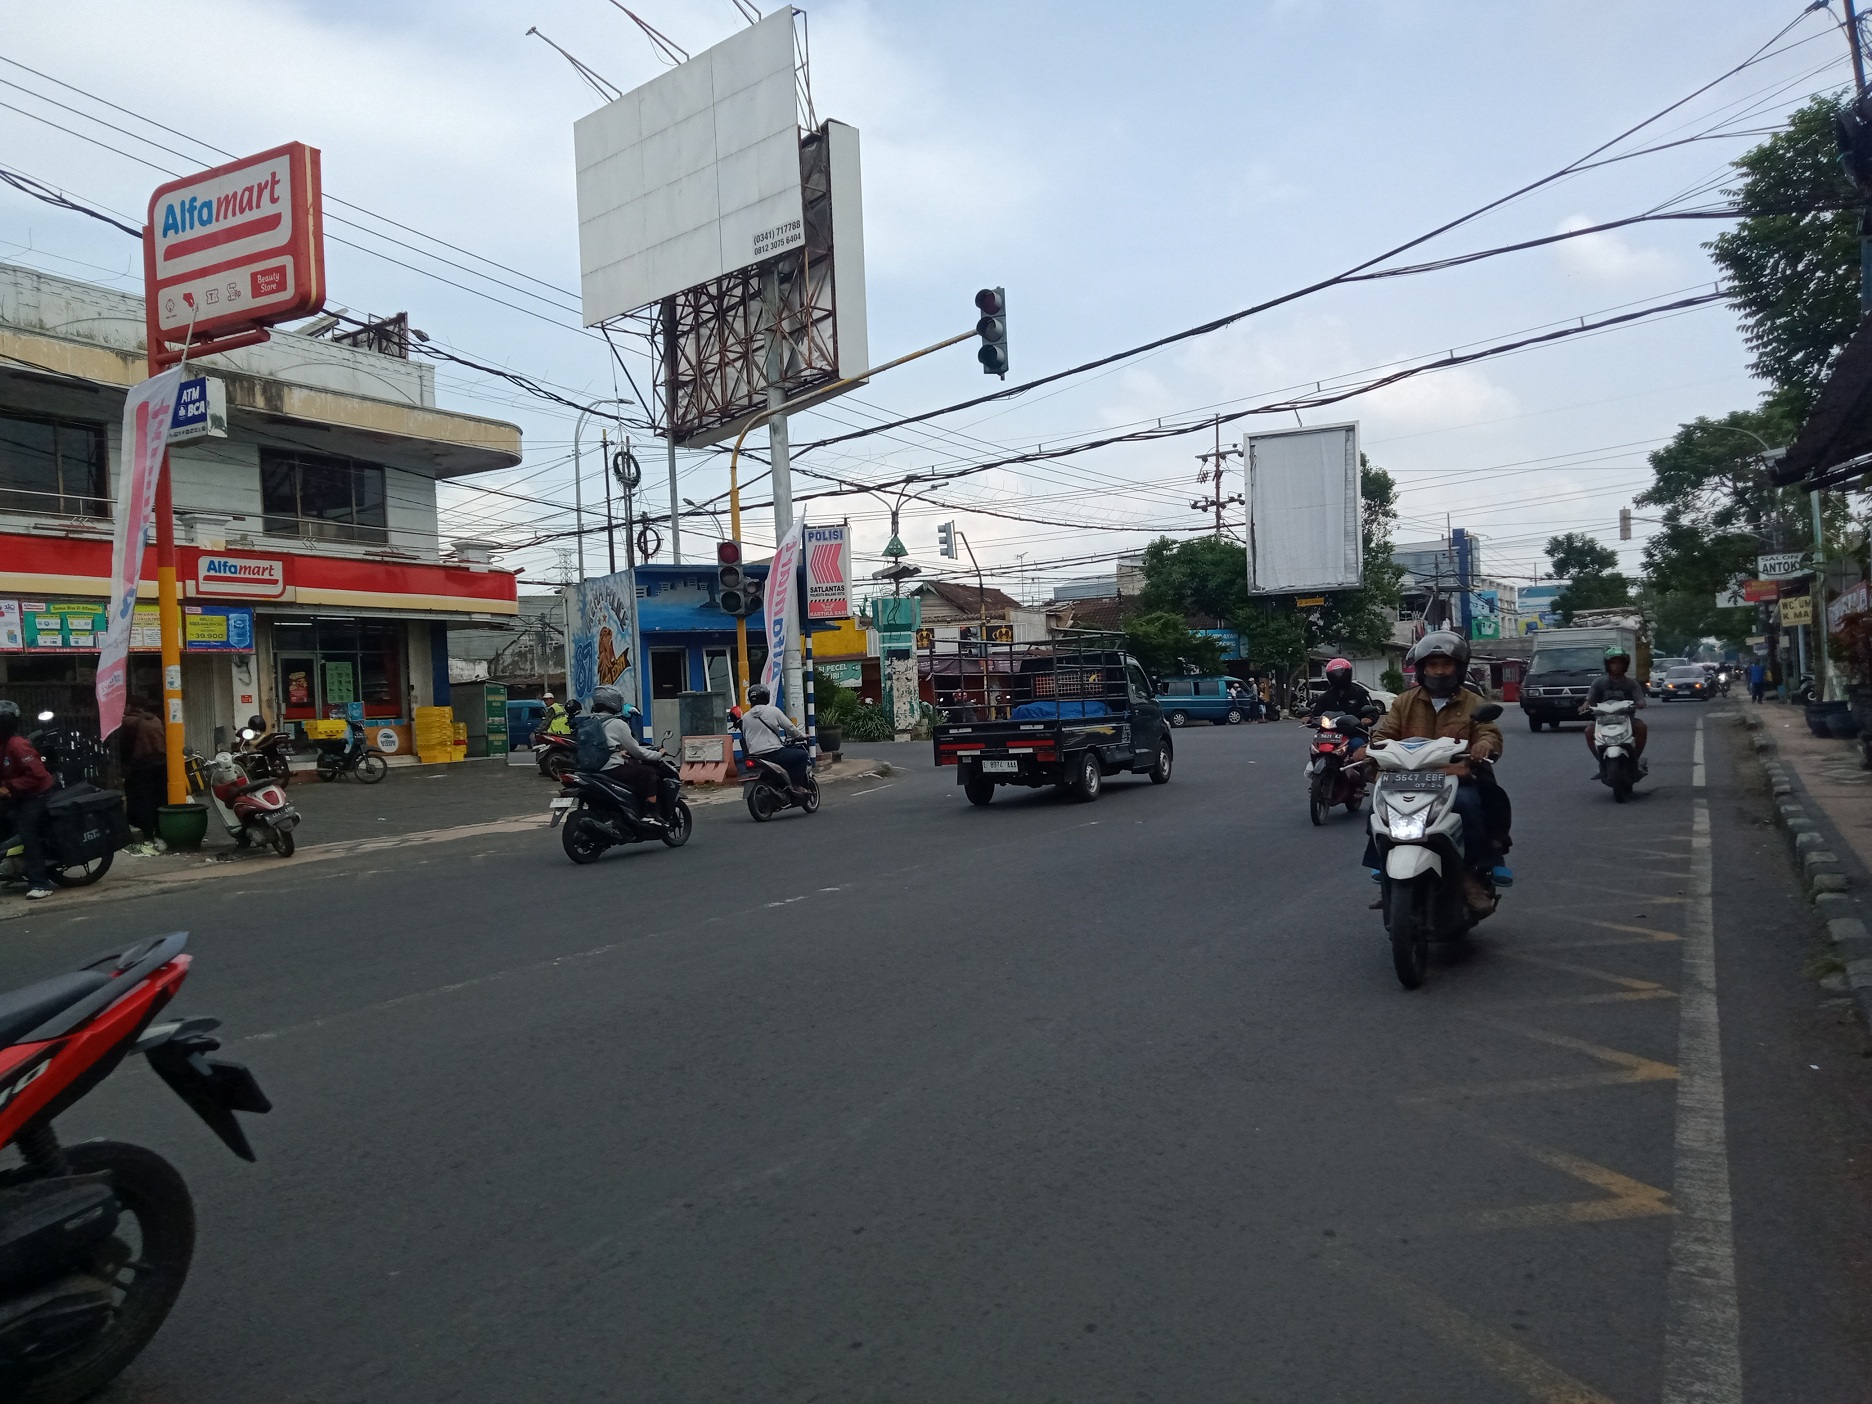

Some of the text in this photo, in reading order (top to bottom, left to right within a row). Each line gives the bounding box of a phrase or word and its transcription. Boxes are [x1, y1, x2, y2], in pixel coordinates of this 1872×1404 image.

[162, 171, 280, 238] Alfamart
[753, 219, 801, 246] (0341) 717788
[754, 232, 801, 256] 0812 3075 6404
[257, 271, 280, 284] Beauty
[260, 282, 277, 293] Store
[181, 386, 200, 403] ATM
[187, 400, 205, 417] BCA
[808, 530, 843, 542] POLISI
[206, 559, 275, 577] Alfamart
[809, 585, 845, 594] SATLANTAS
[1781, 601, 1794, 610] WC
[576, 640, 593, 698] 87
[826, 663, 848, 672] PECEL
[1395, 773, 1419, 781] 5647
